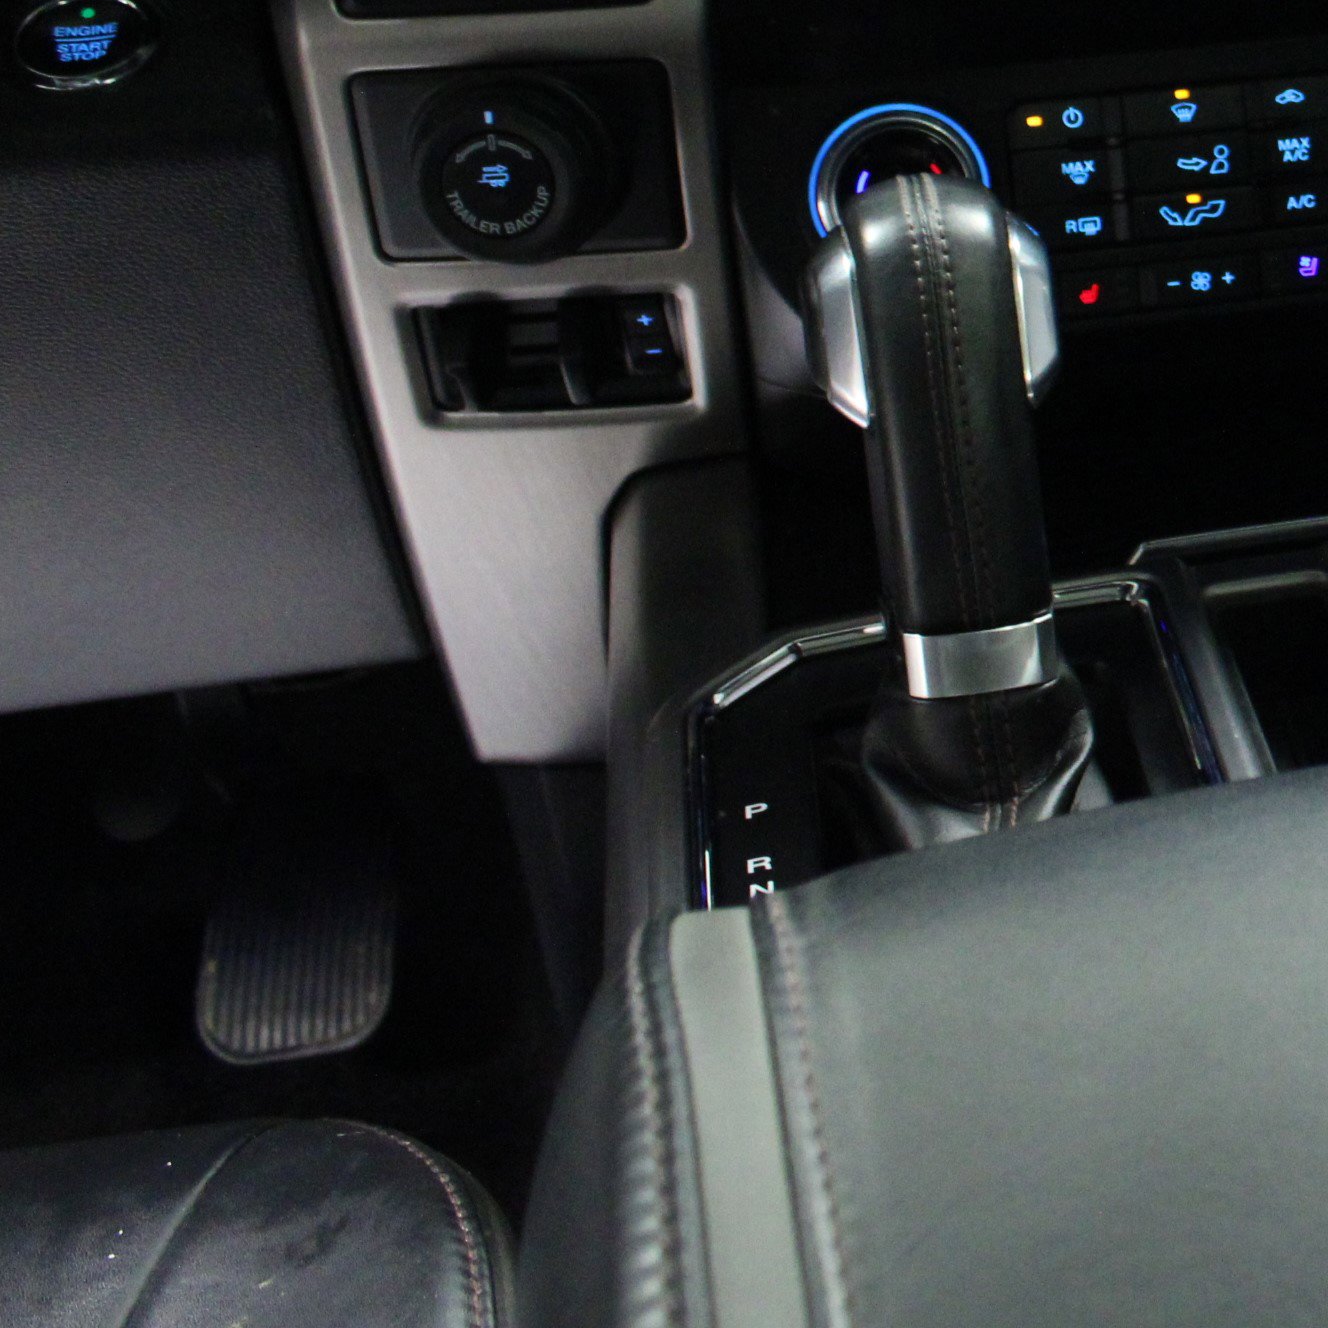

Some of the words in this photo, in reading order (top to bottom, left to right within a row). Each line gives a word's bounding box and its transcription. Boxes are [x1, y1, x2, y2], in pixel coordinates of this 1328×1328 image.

[53, 22, 120, 37] ENGINE
[57, 40, 112, 53] START
[58, 50, 107, 63] STOP
[1277, 136, 1311, 152] MAX
[1280, 148, 1312, 162] A/C
[1060, 159, 1096, 174] MAX
[1286, 194, 1317, 210] A/C
[446, 190, 501, 235] TRAILER
[502, 185, 551, 235] BACKUP
[1065, 219, 1077, 233] R
[744, 802, 768, 820] P
[746, 856, 772, 874] R
[750, 880, 775, 898] N
